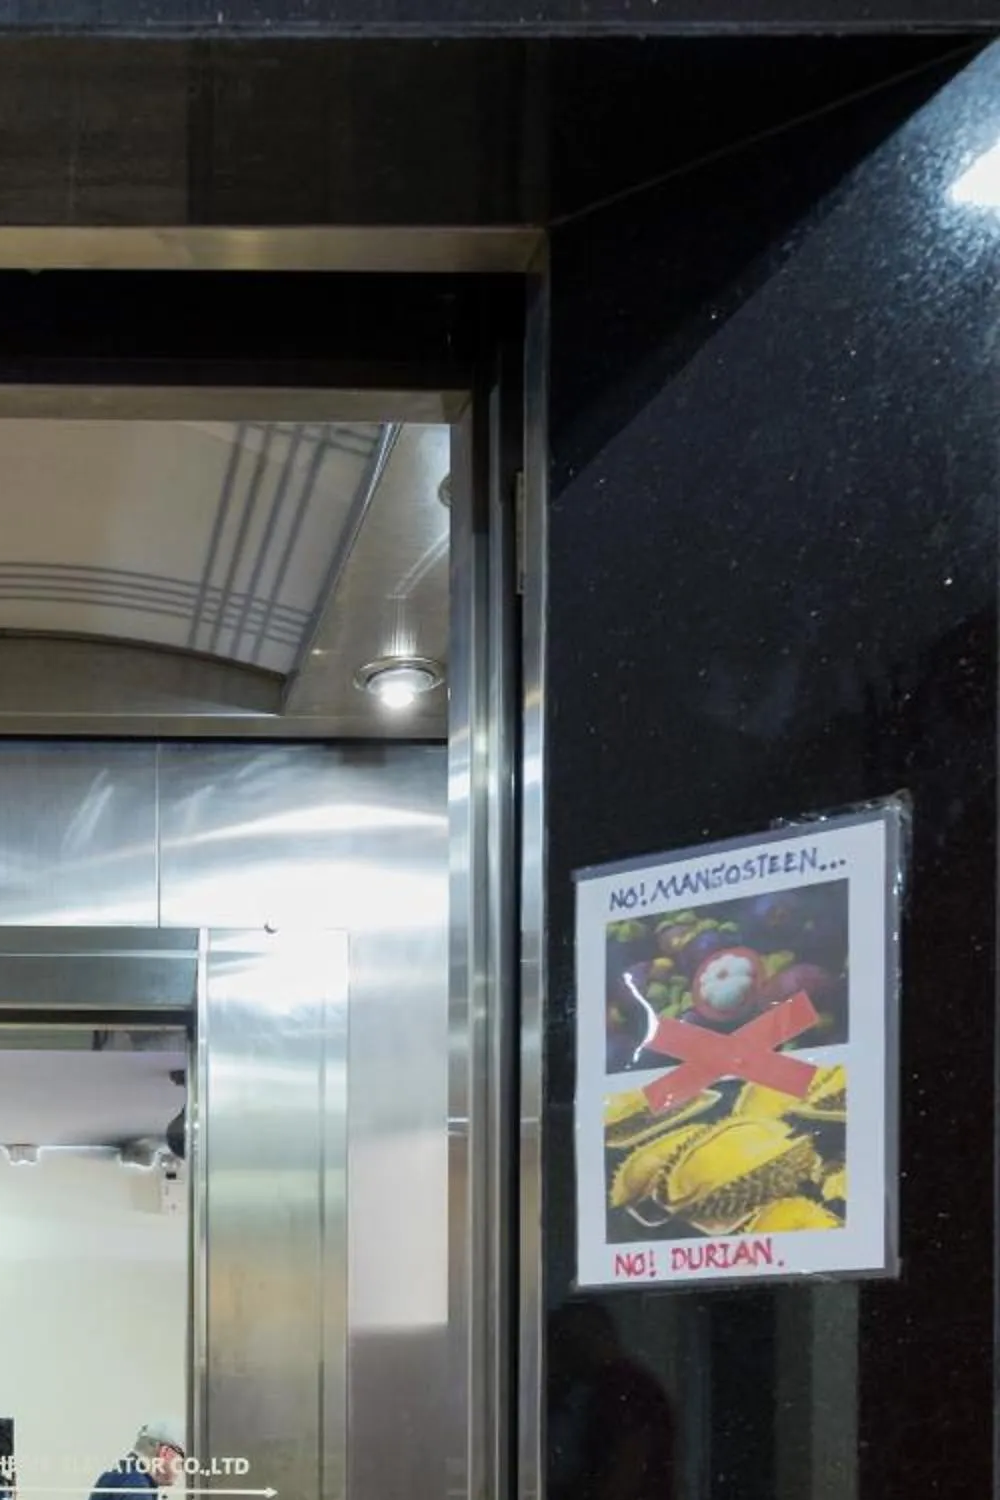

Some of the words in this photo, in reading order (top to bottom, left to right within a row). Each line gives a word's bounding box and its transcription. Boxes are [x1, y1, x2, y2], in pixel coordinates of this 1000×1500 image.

[609, 882, 647, 912] NO!
[615, 1248, 657, 1278] NO!
[671, 1238, 785, 1271] DURIAN.
